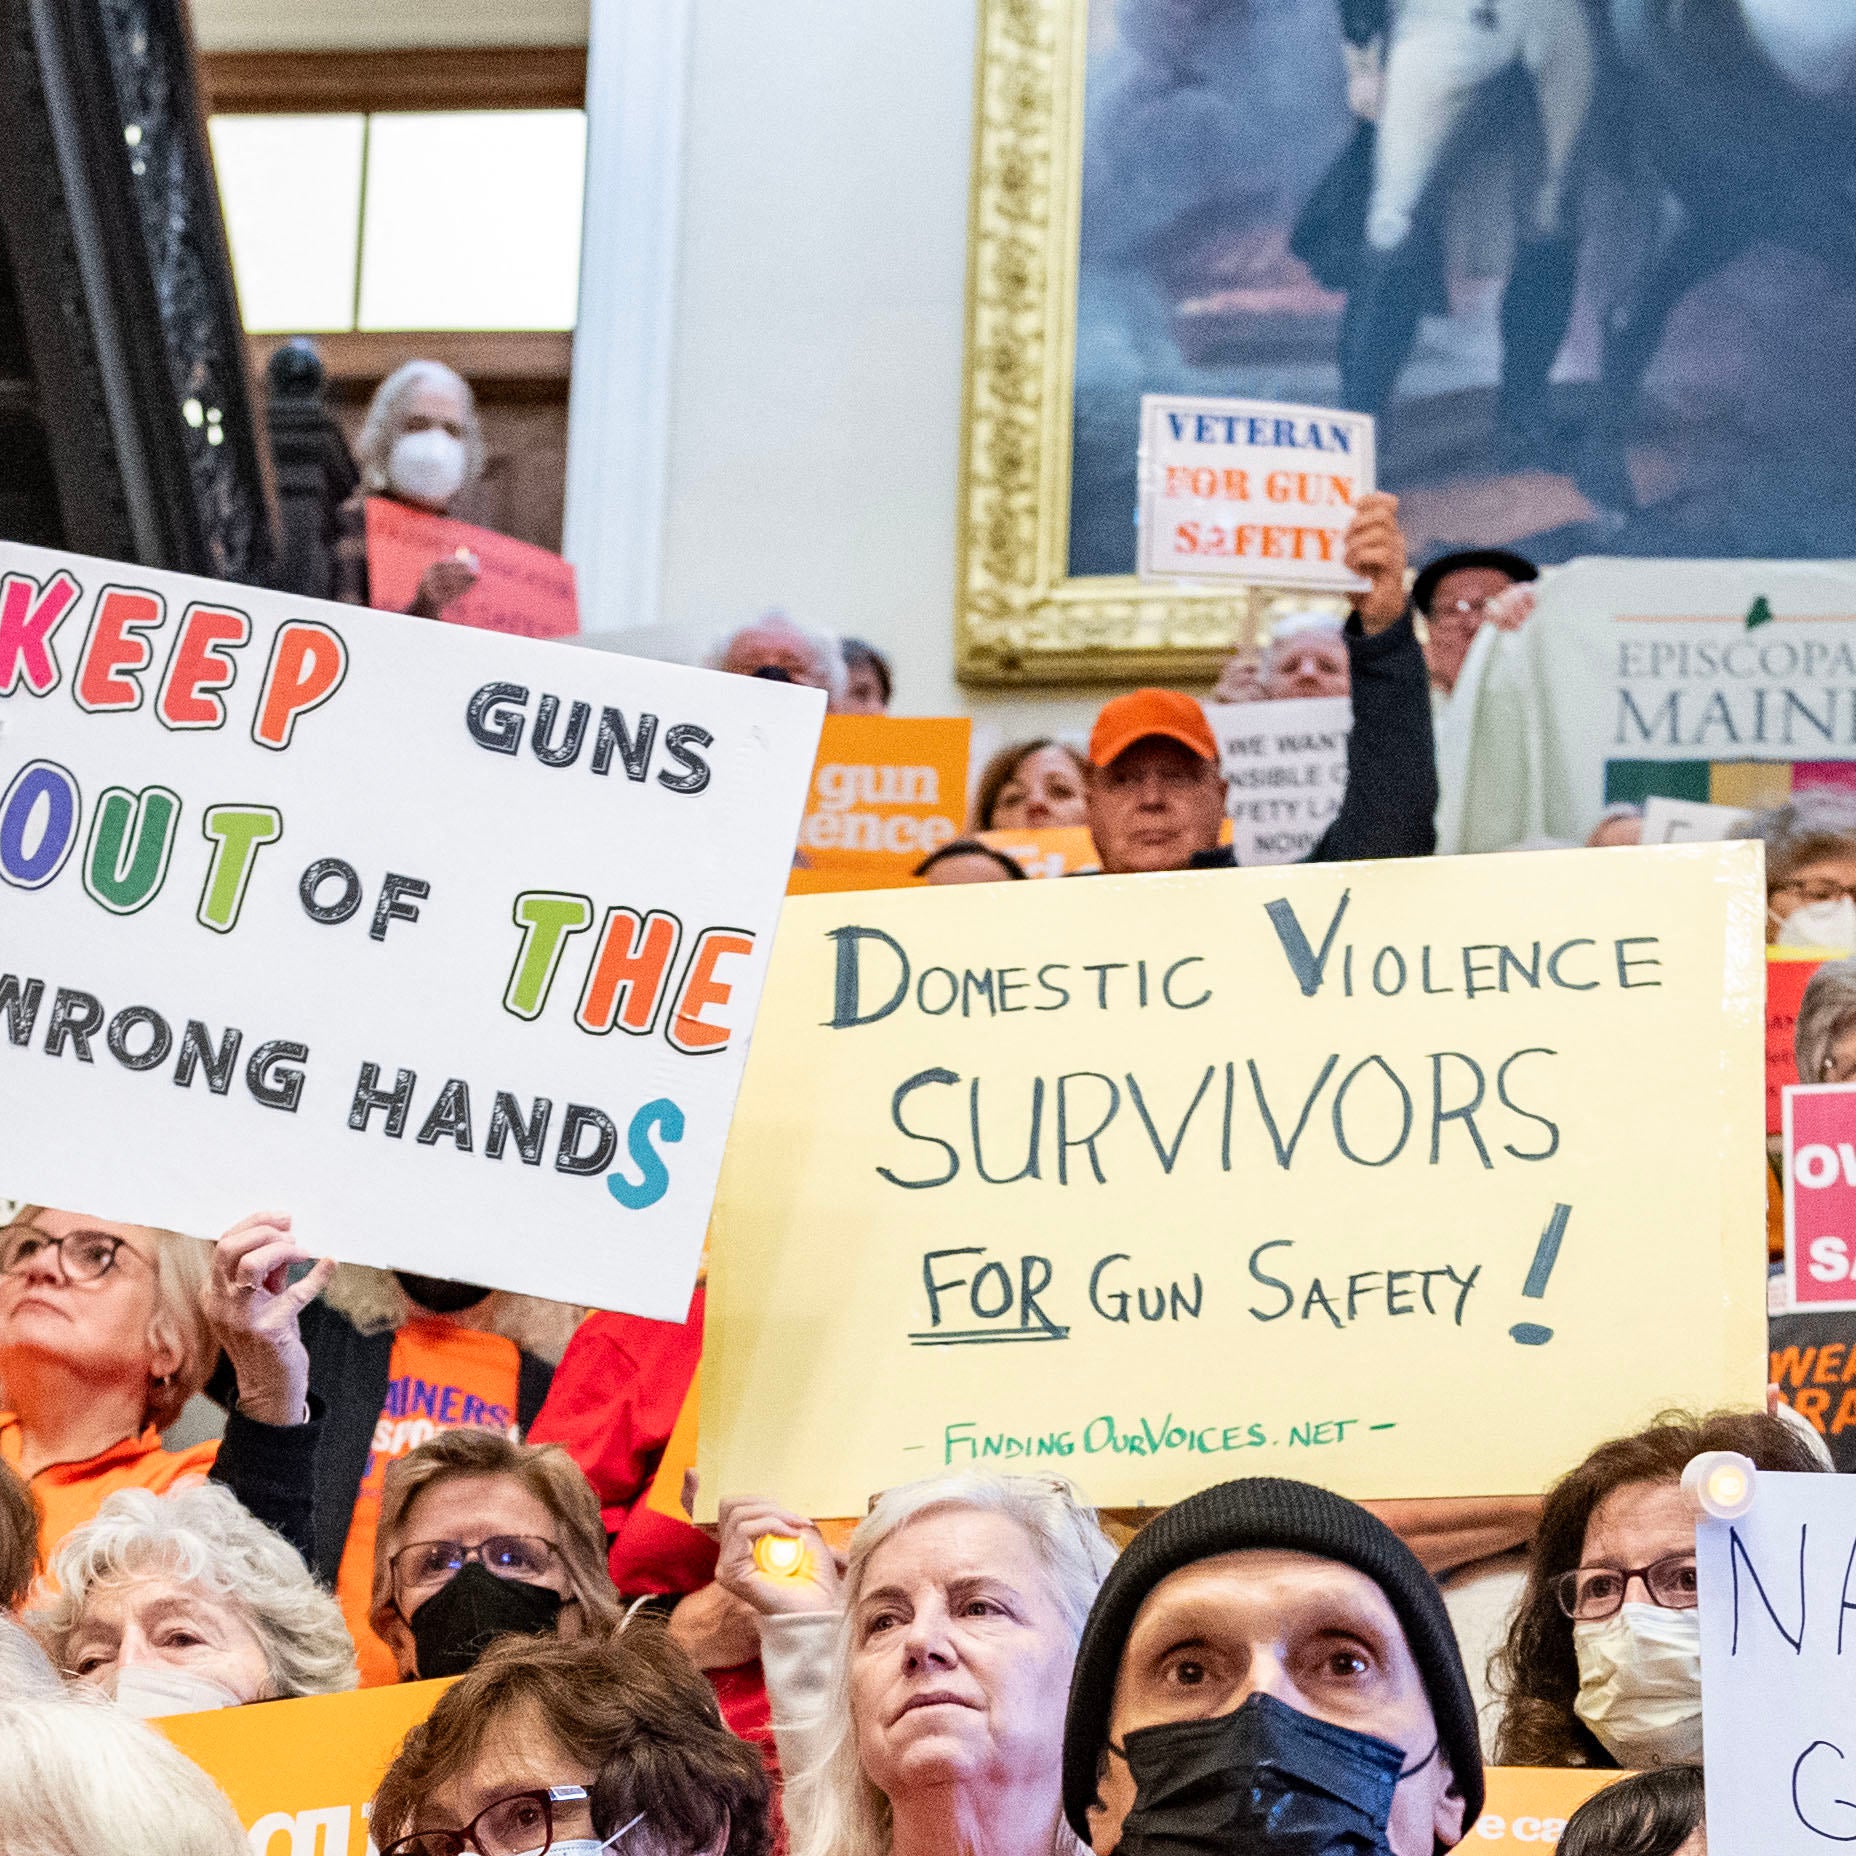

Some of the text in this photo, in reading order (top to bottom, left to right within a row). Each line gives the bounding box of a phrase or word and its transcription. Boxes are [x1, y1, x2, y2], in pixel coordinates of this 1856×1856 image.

[1167, 412, 1352, 454] VETERAN
[1166, 466, 1353, 505] FOR GUN
[466, 682, 712, 795] GUNS
[819, 764, 939, 813] gun
[300, 859, 430, 941] OF
[504, 891, 755, 1055] THE
[820, 890, 1661, 1030] DOMESTIC VIOLENCE
[348, 1063, 685, 1210] HANDS
[876, 1049, 1559, 1189] SURVIVORS
[923, 1246, 1069, 1327] FOR
[1512, 1815, 1568, 1843] ca
